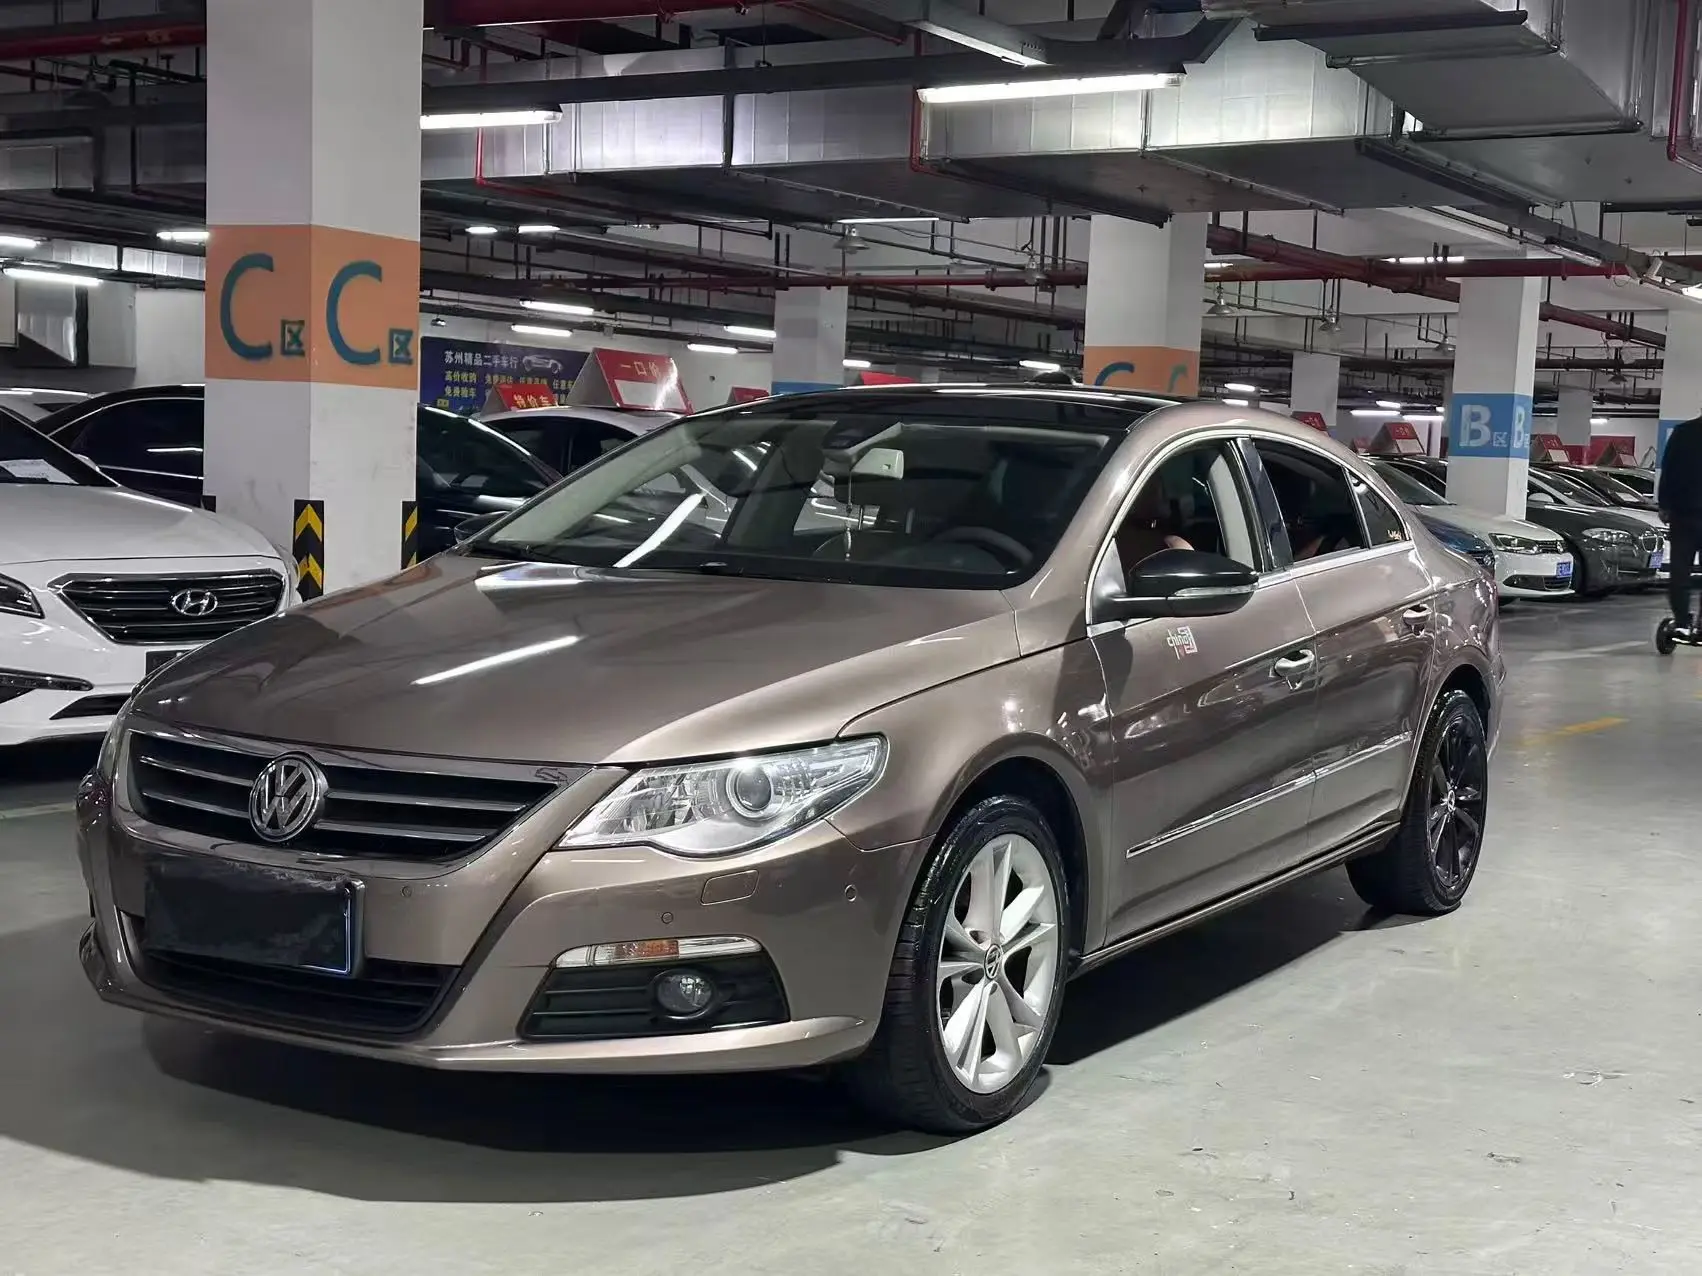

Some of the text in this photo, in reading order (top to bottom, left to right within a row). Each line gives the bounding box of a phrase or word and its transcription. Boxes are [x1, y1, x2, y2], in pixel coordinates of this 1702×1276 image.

[220, 252, 306, 361] C区
[326, 260, 414, 366] C区
[444, 350, 519, 370] 苏州精品二手车行
[1459, 404, 1508, 448] B区
